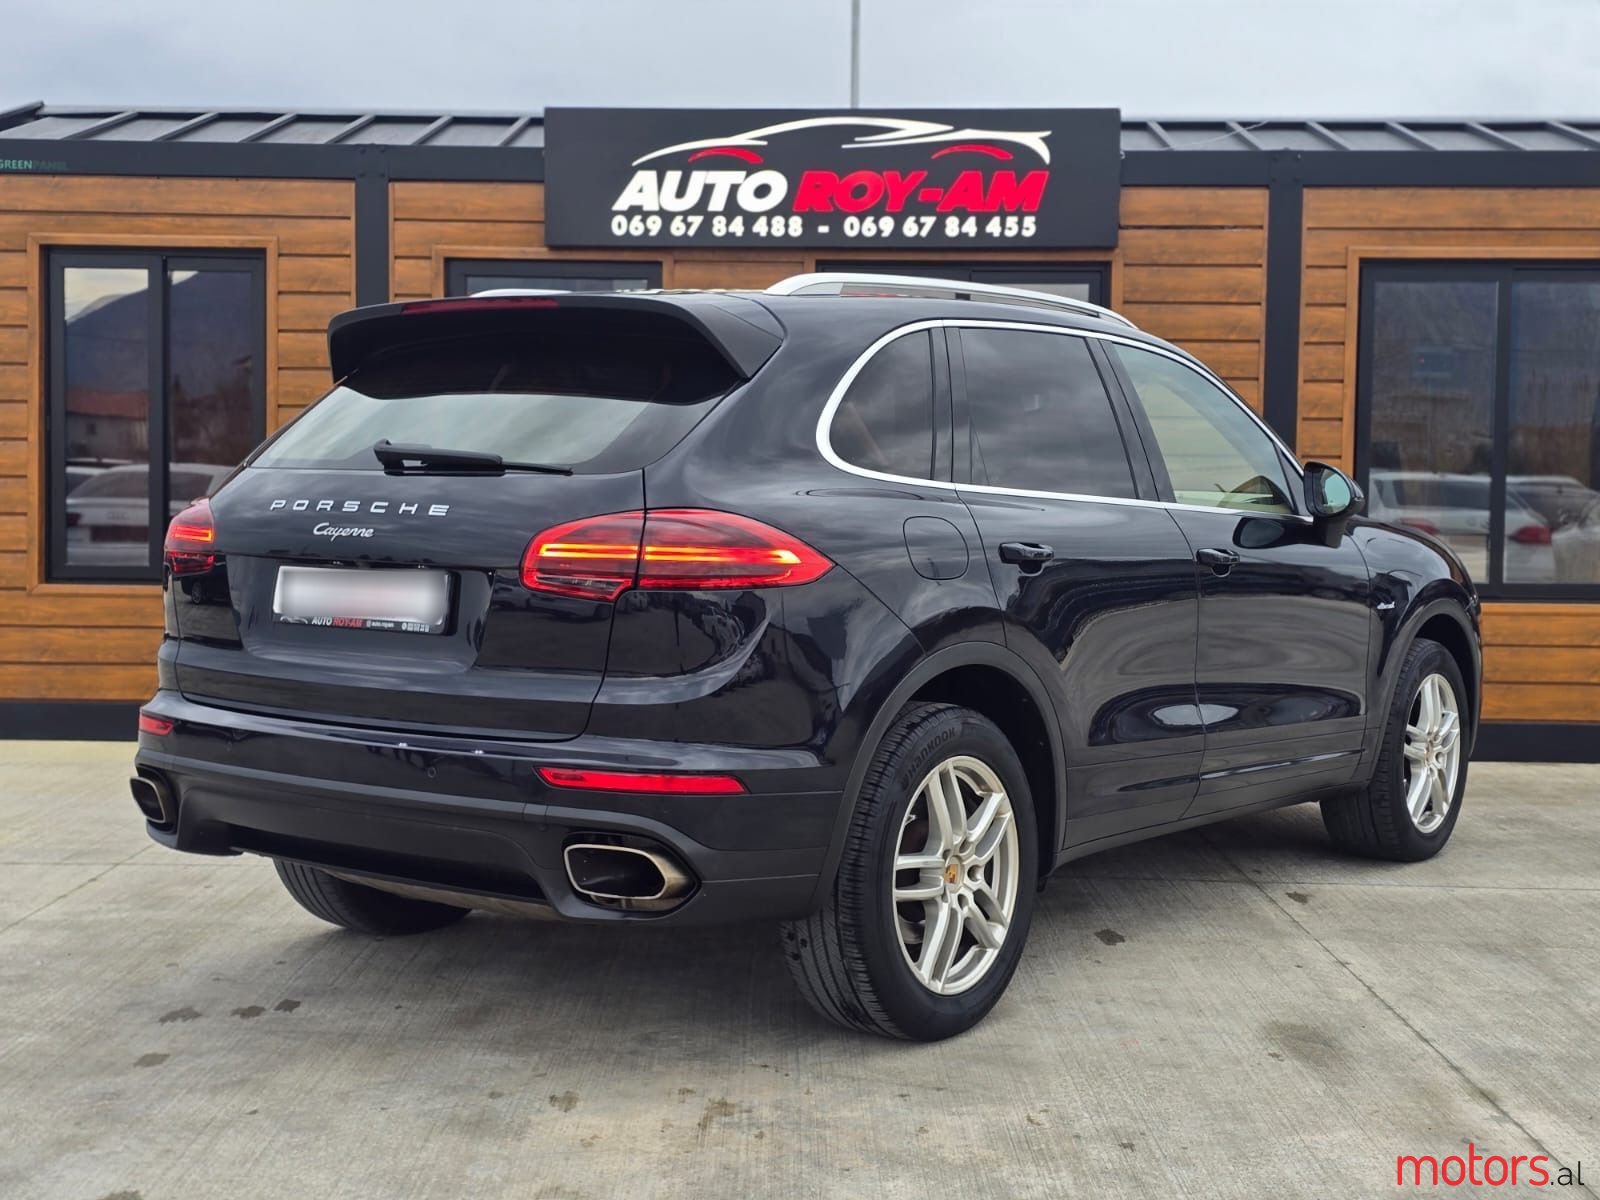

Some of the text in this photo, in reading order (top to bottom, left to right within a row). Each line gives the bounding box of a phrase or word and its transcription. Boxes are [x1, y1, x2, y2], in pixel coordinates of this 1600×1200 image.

[611, 169, 1050, 213] AUTO ROY-AM
[610, 214, 662, 238] 069
[668, 214, 705, 238] 67
[711, 214, 745, 238] 84
[752, 214, 804, 238] 488
[843, 214, 895, 238] 069
[902, 214, 937, 238] 67
[944, 214, 978, 238] 84
[985, 214, 1037, 238] 455
[270, 499, 450, 516] PORSCHE
[313, 522, 375, 542] Cayenne
[311, 616, 333, 626] AUTO
